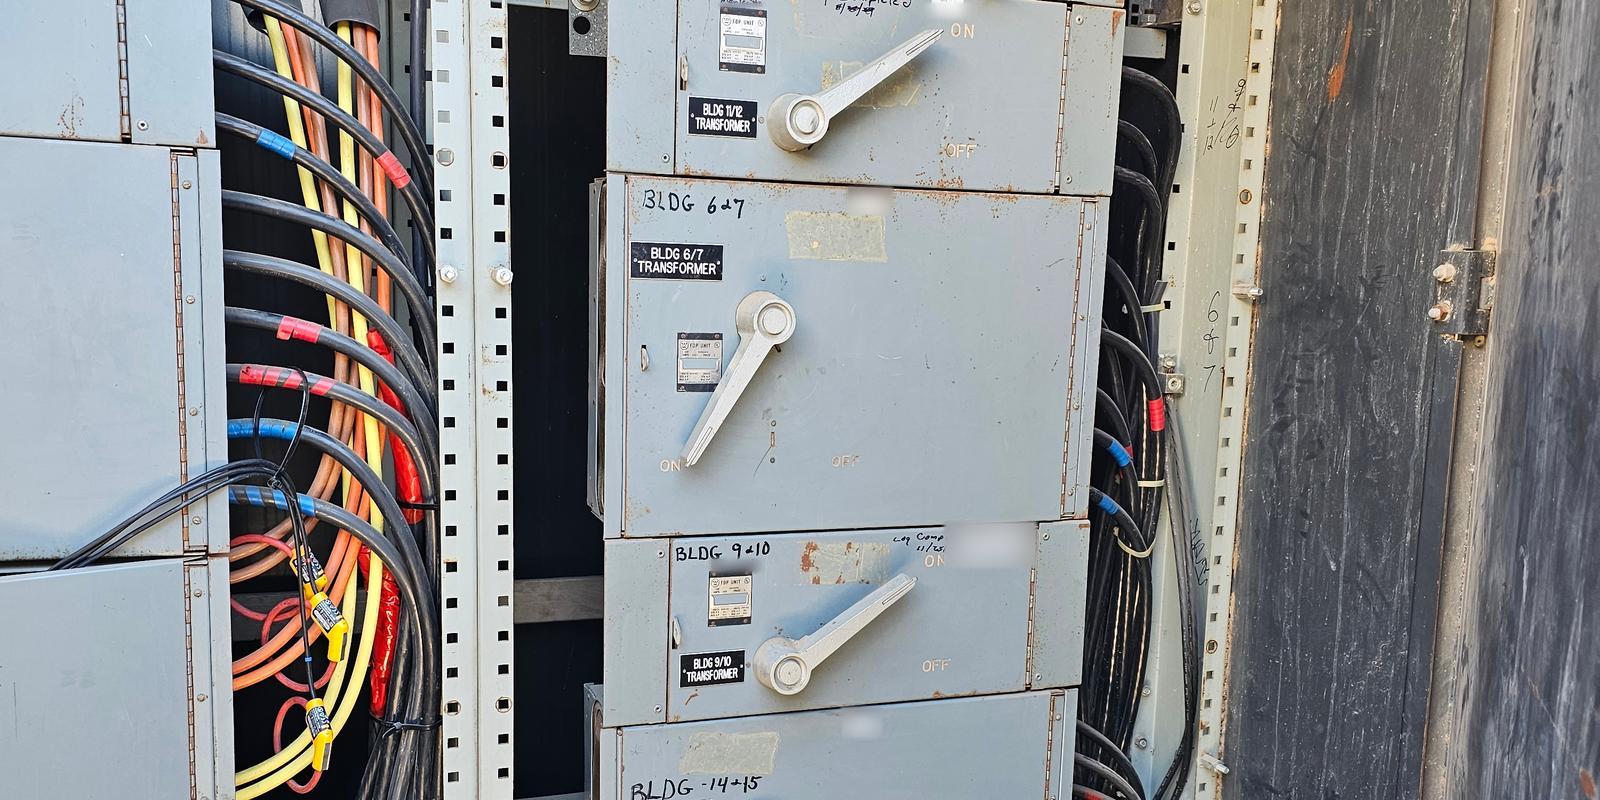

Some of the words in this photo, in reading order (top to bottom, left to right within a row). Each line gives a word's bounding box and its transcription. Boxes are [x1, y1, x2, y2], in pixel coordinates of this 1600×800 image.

[951, 23, 975, 39] ON
[703, 103, 724, 118] BLDG
[726, 105, 743, 119] 11/12
[695, 116, 750, 132] TRANSFORMER
[944, 143, 977, 158] OFF
[643, 189, 695, 212] BLDG
[651, 247, 680, 260] BLDG
[683, 249, 704, 261] 6/7
[638, 260, 717, 275] TRANSFORMER
[660, 459, 682, 472] ON
[832, 455, 860, 468] OFF
[675, 545, 722, 561] BLDG
[693, 658, 713, 669] BLDG
[714, 656, 732, 668] 9/10
[922, 660, 949, 673] OFF
[686, 667, 738, 683] TRANSFORMER
[631, 778, 694, 800] BLDG
